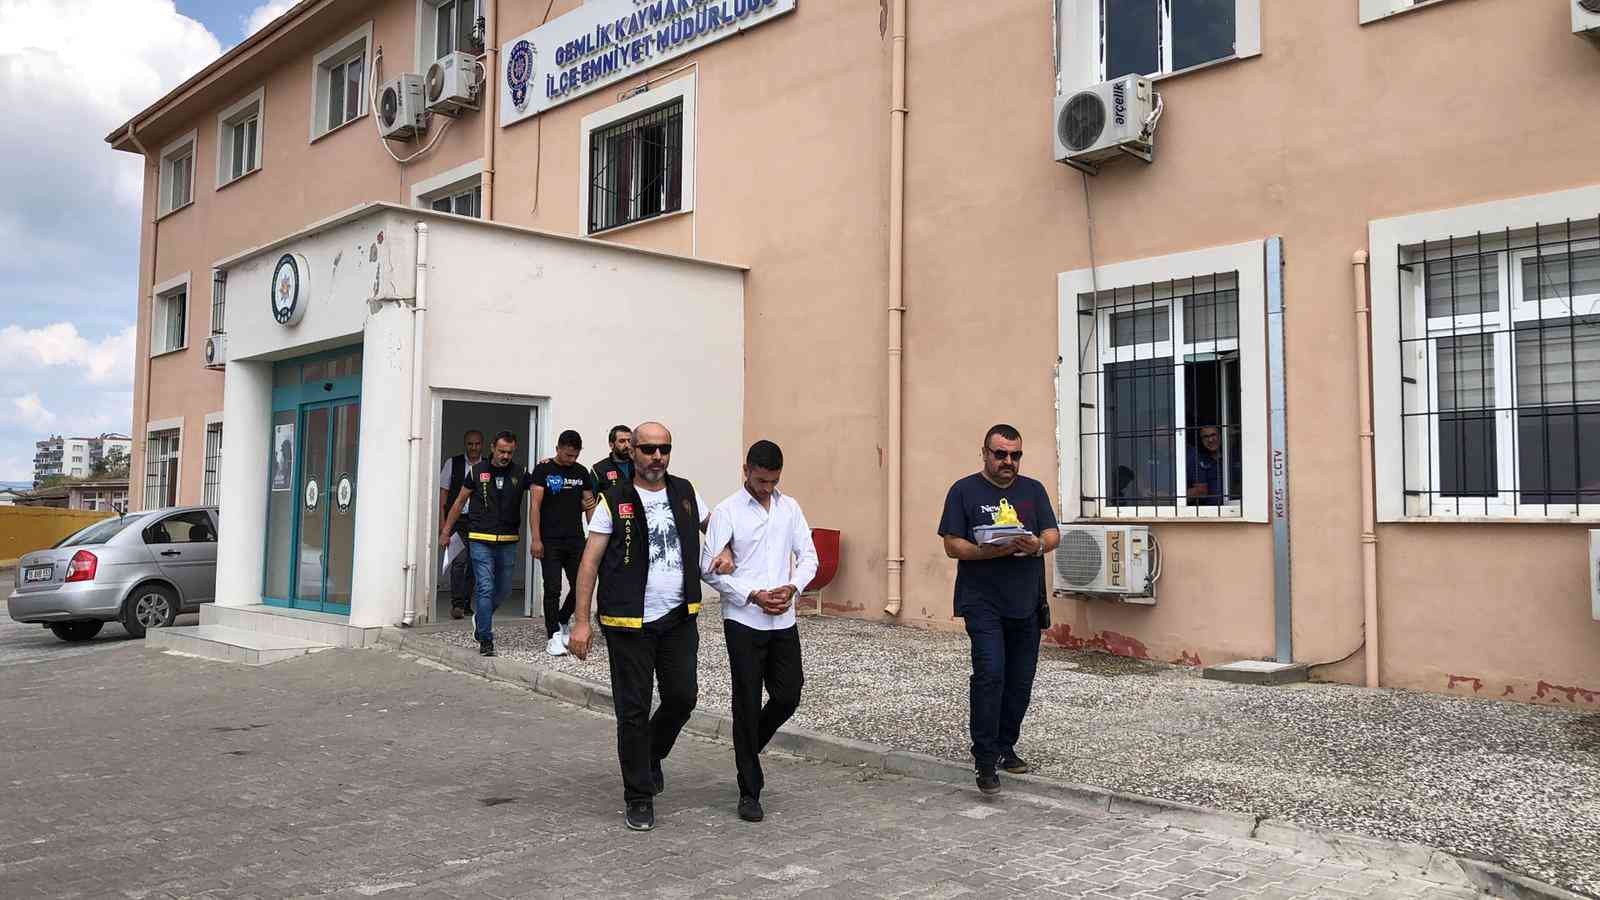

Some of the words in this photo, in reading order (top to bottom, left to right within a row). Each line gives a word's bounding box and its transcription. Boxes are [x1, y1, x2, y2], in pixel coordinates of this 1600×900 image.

[555, 23, 611, 66] GEMLİK
[580, 34, 653, 83] EMNİYET
[1113, 83, 1126, 125] arçelik
[1274, 450, 1282, 477] CCTV
[1111, 531, 1120, 586] REGAL
